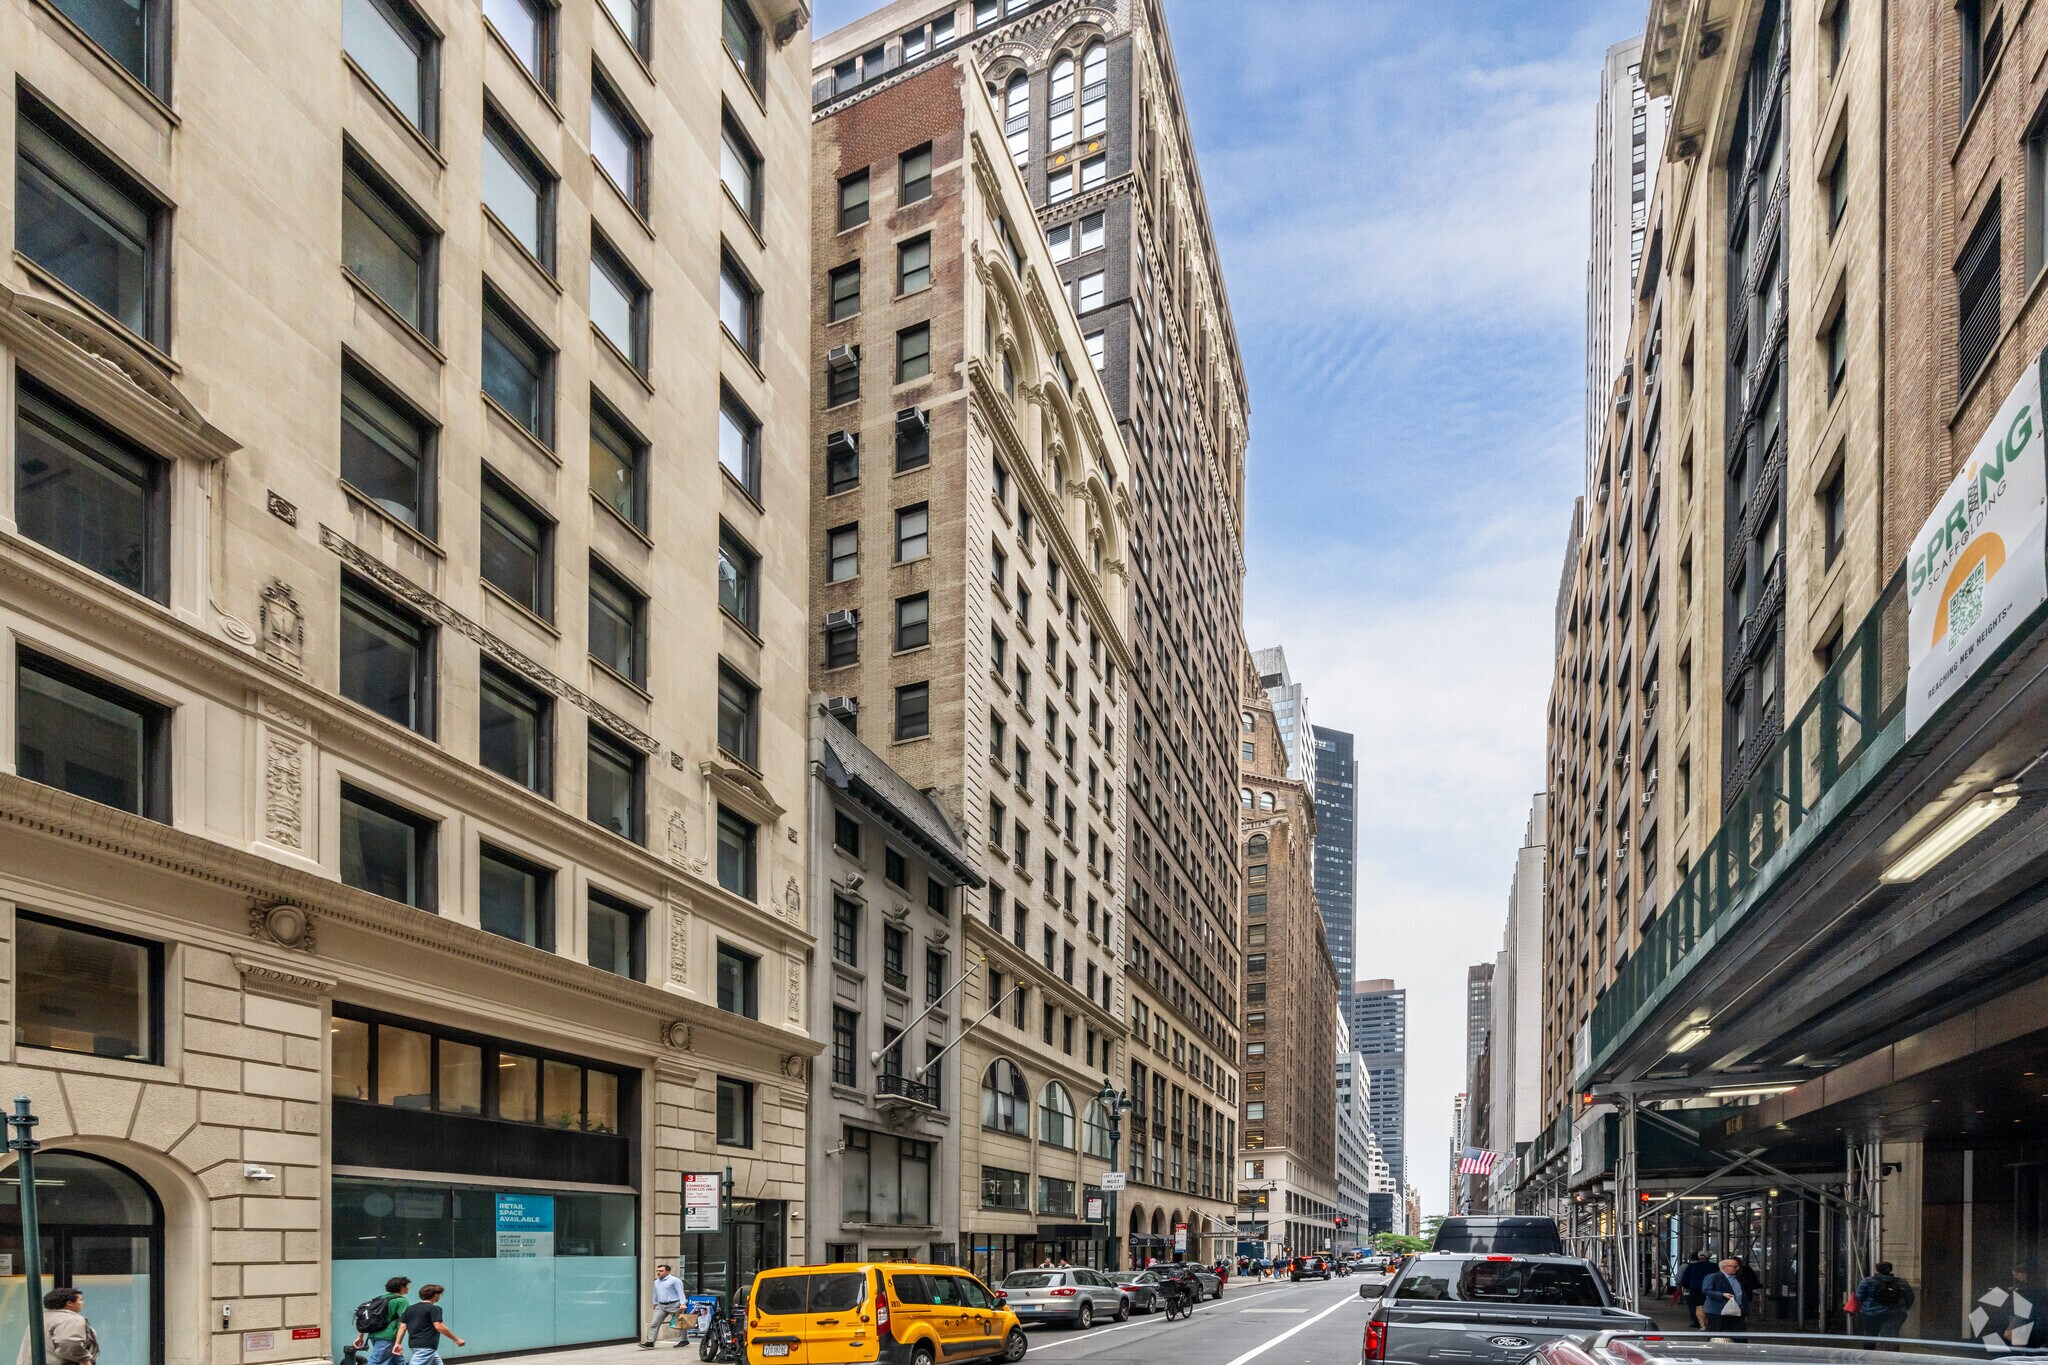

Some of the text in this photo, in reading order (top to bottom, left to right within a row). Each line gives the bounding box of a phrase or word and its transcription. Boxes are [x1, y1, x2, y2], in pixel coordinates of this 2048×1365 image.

[1928, 480, 2007, 591] SCAFFOLDING
[1927, 661, 1958, 700] REACHING
[1959, 643, 1975, 664] NEW
[1498, 1338, 1522, 1346] Ford
